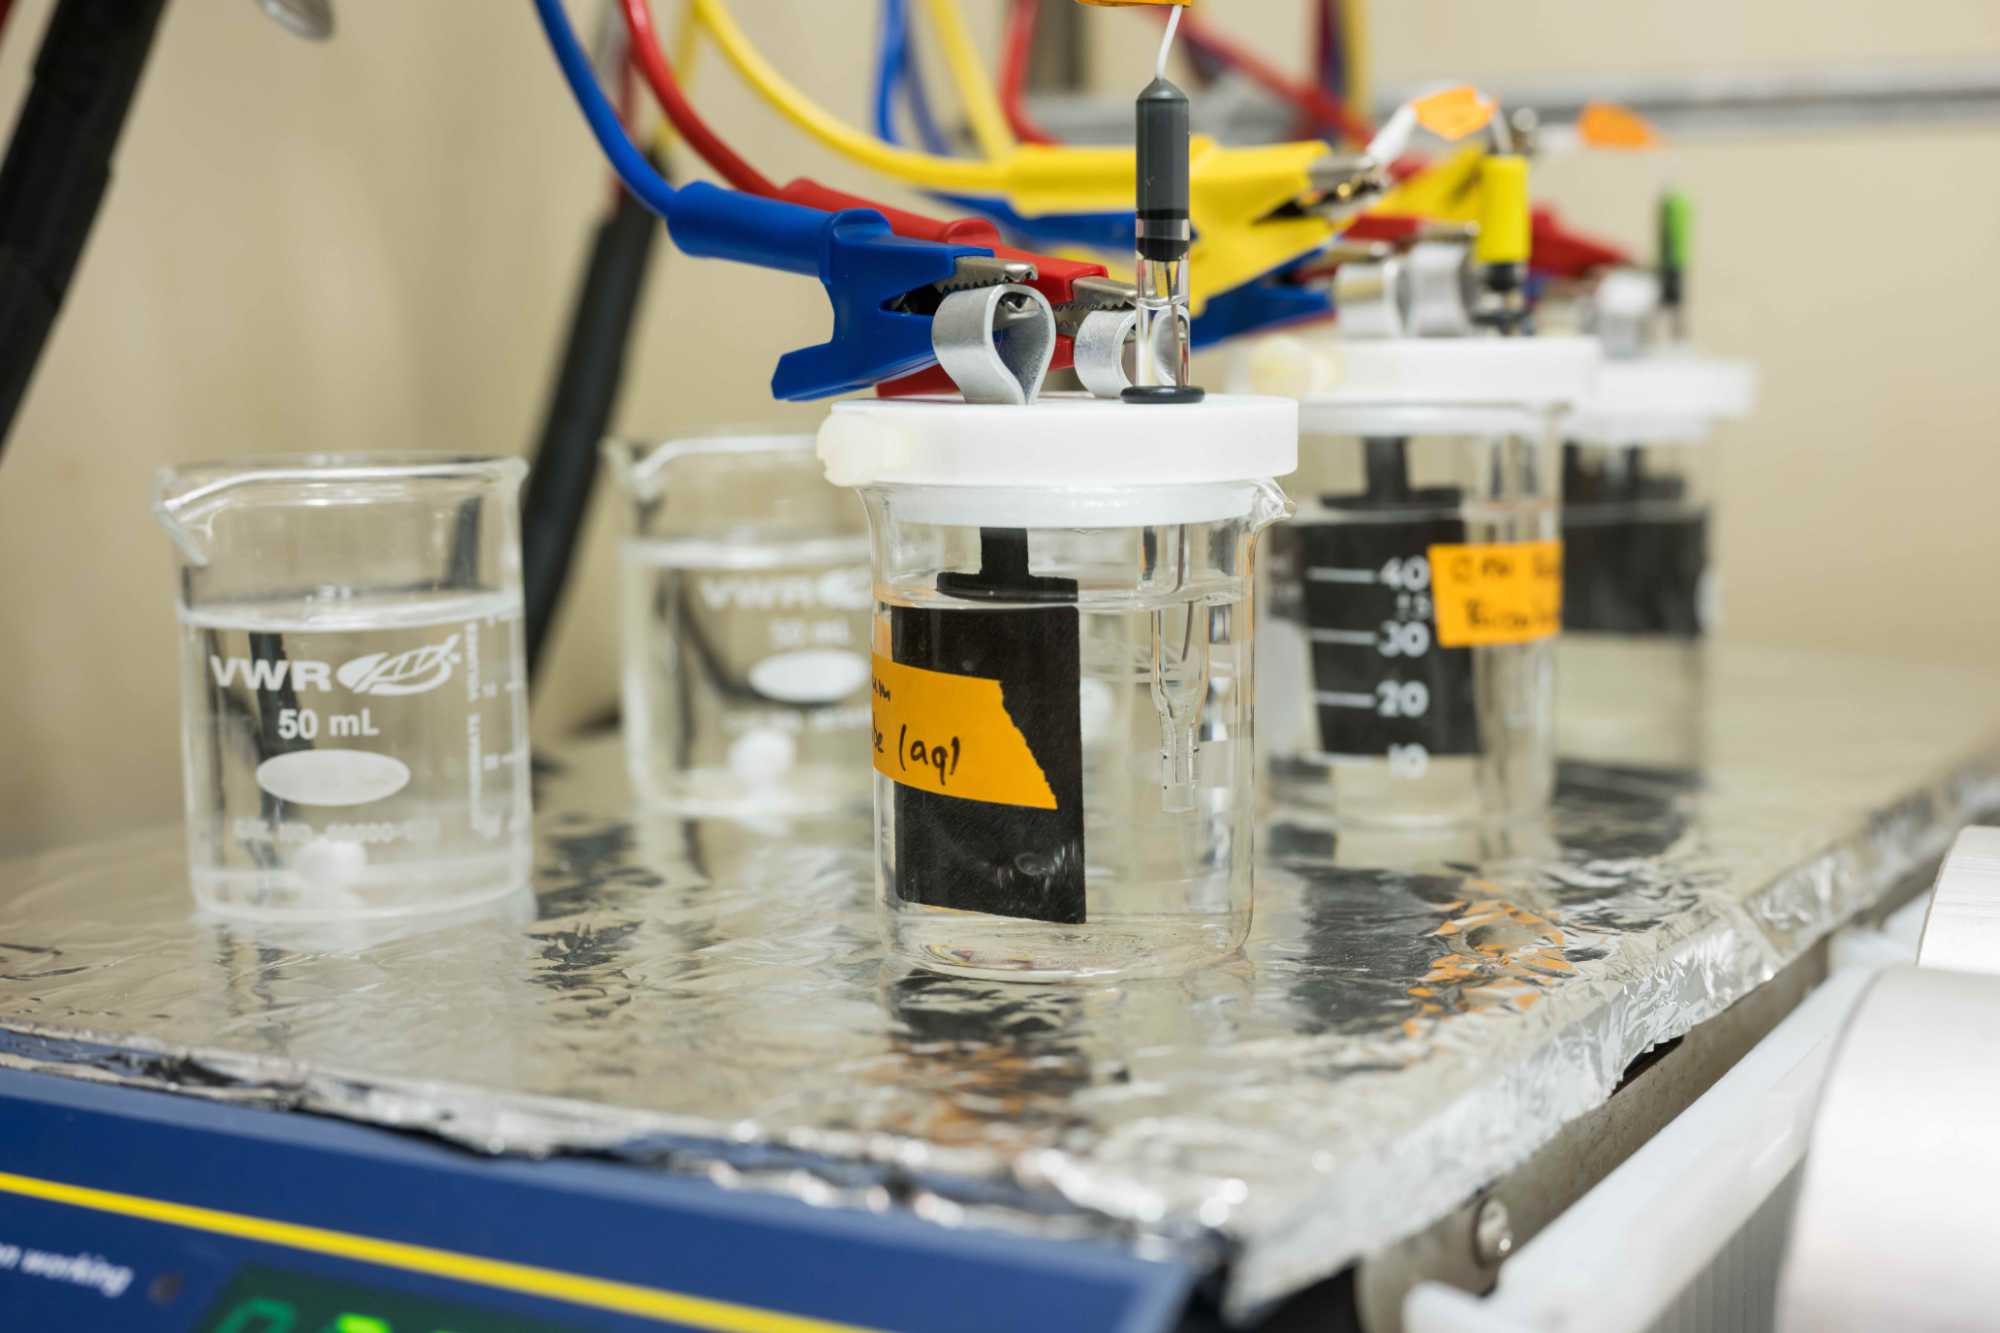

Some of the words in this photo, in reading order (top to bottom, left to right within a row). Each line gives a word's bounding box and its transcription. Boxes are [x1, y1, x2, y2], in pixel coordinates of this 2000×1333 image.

[1379, 555, 1430, 592] 40
[1377, 619, 1430, 658] 30
[209, 654, 333, 692] VWR
[1375, 679, 1429, 718] 20
[277, 708, 319, 740] 50
[328, 708, 381, 737] mL
[898, 723, 961, 787] (aq)
